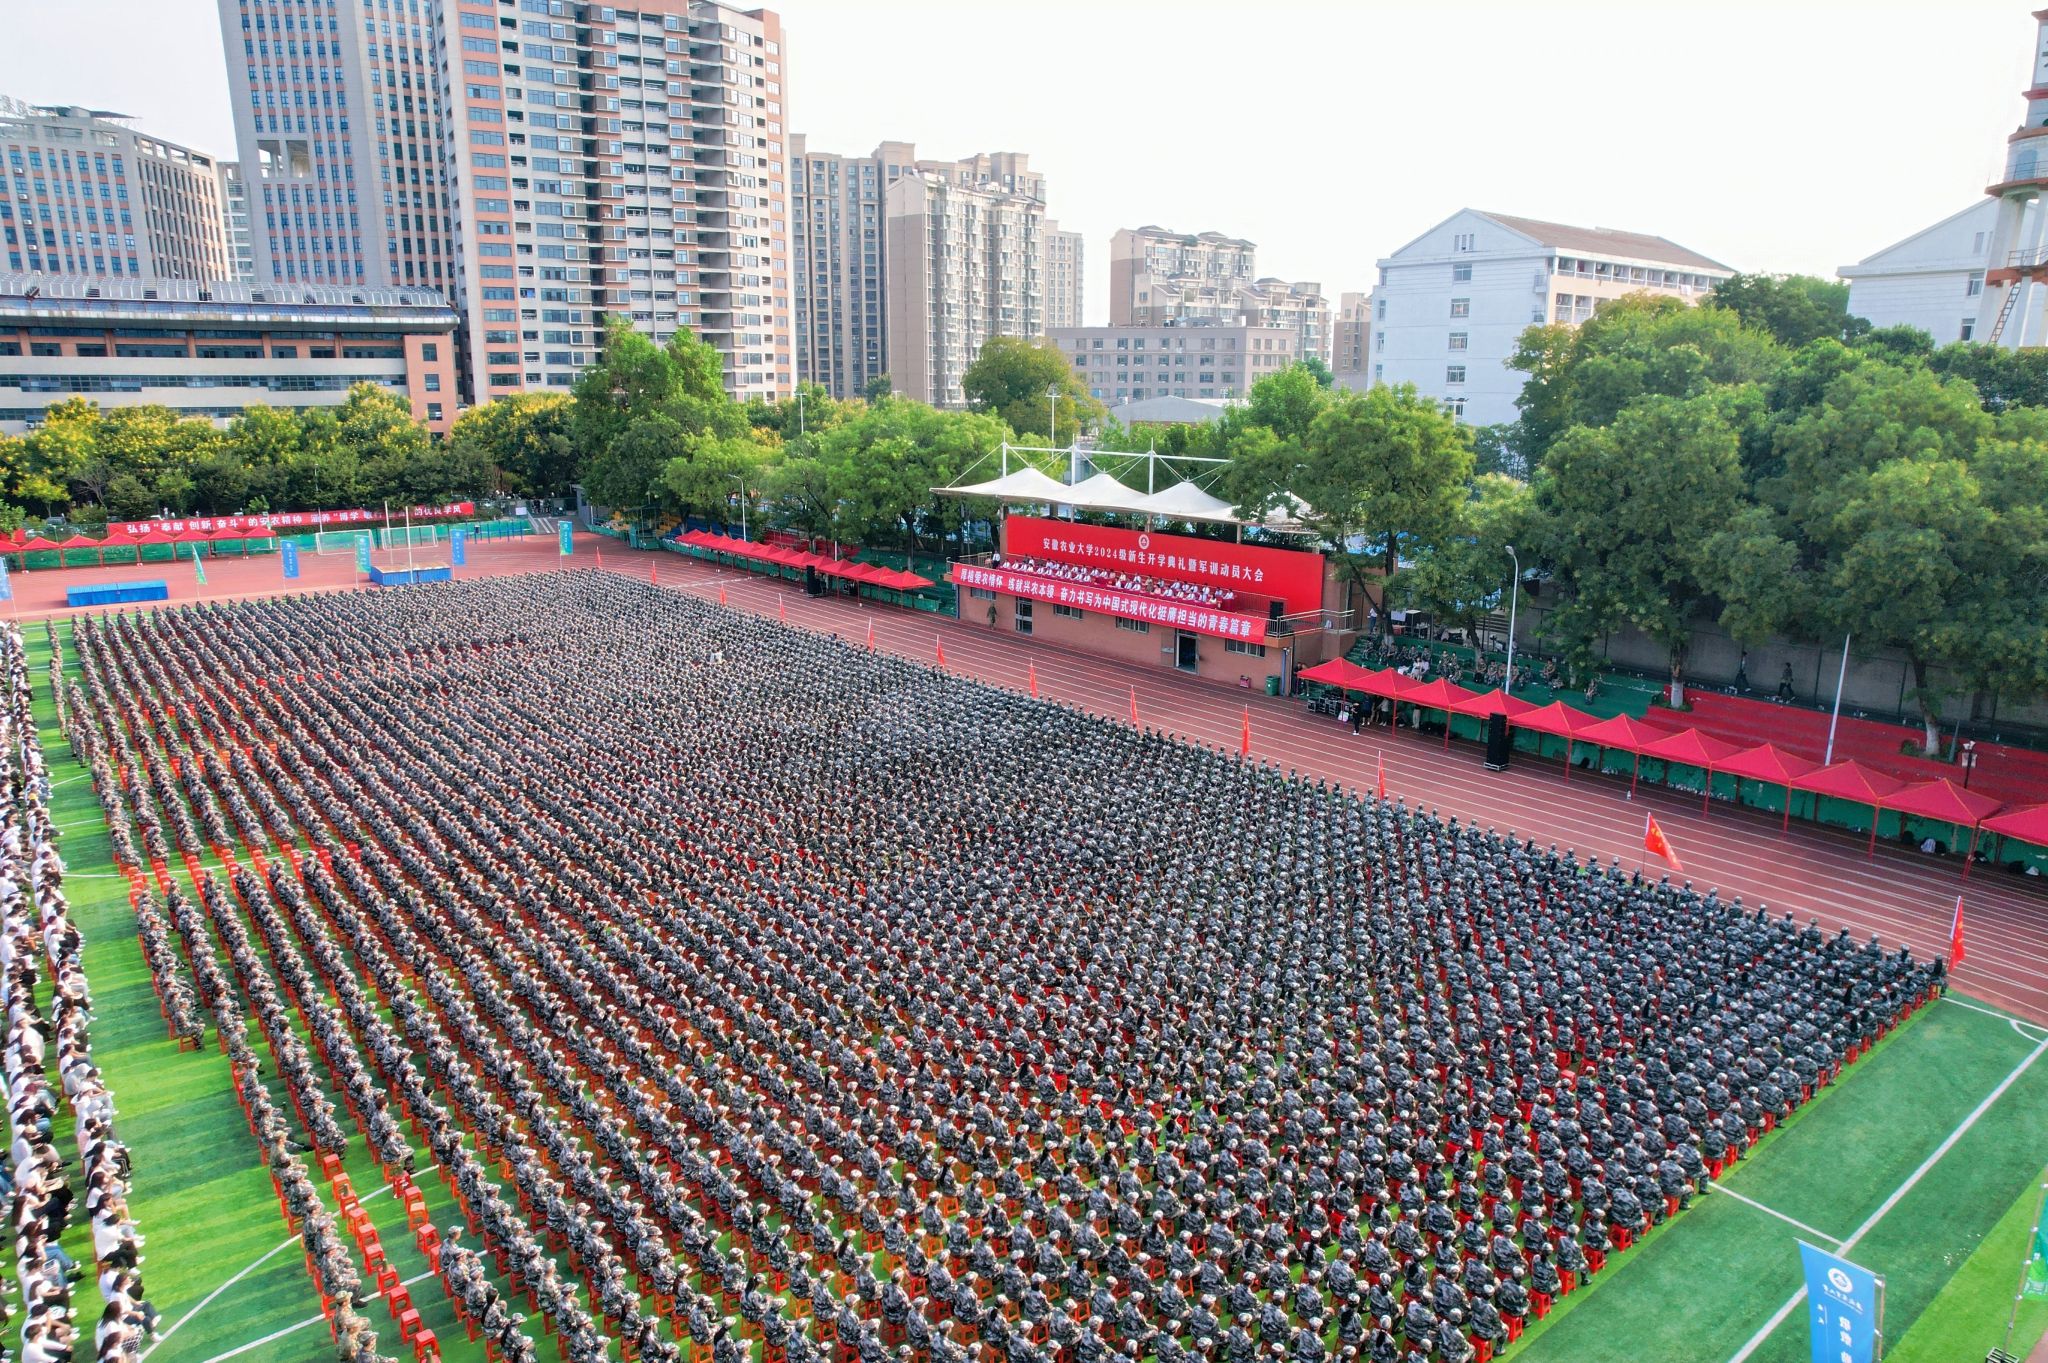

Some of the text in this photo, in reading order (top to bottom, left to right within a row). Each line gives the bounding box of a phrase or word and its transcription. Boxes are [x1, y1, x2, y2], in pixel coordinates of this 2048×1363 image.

[1043, 537, 1264, 582] 安徽农业大学2024级新生开学典礼暨军训动员大会
[960, 568, 1252, 638] 厚植爱农情怀 练就兴农本领 奋力书写为中国式现代化挺膺担当的青春篇章
